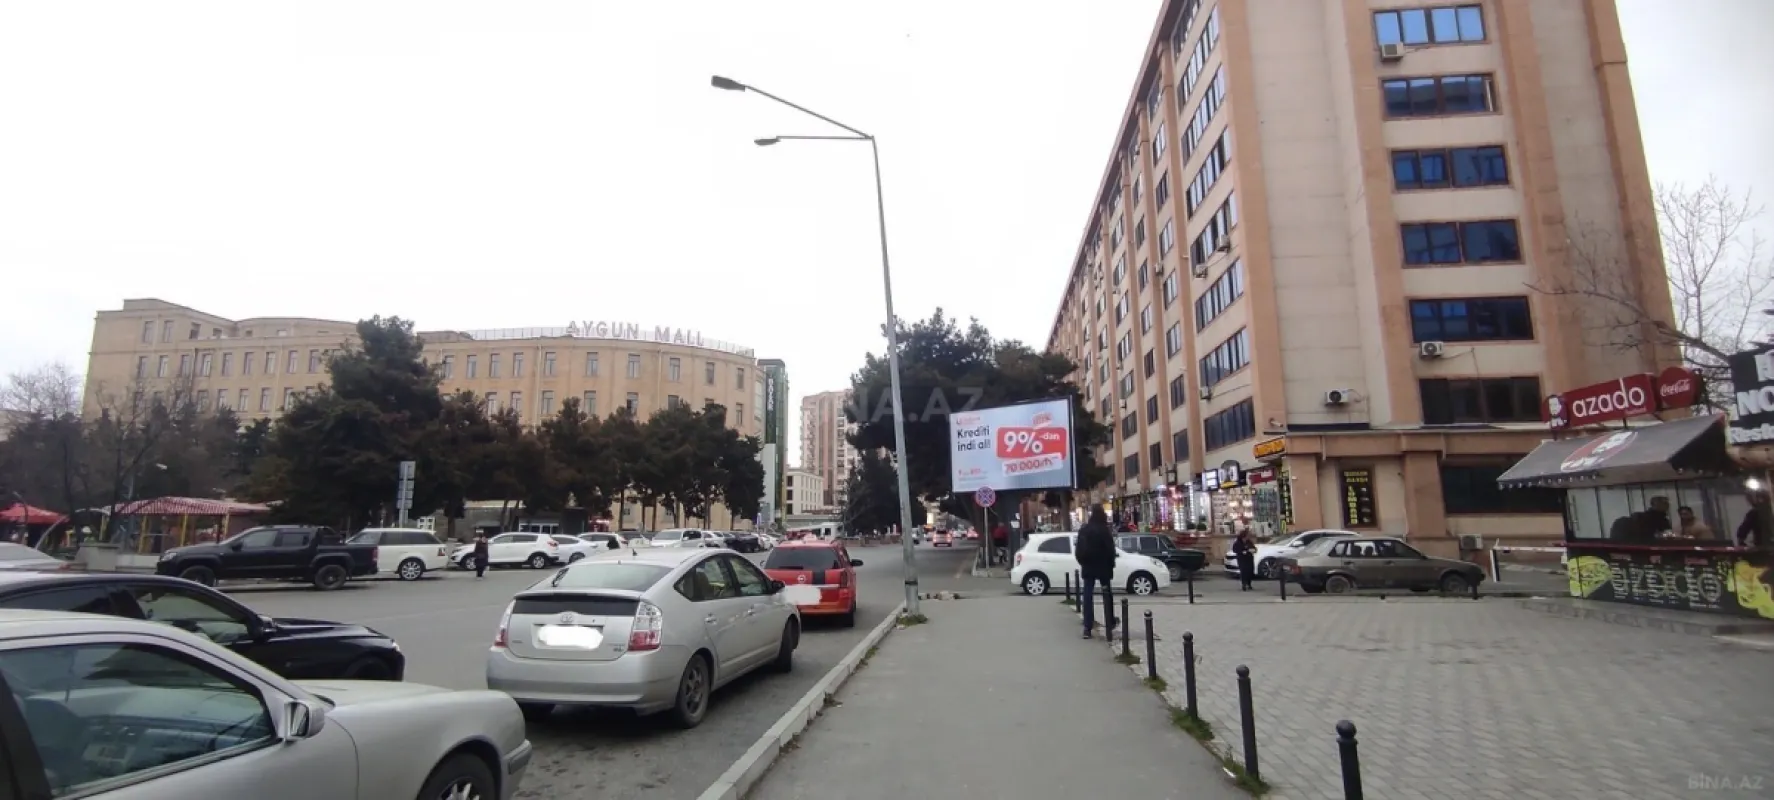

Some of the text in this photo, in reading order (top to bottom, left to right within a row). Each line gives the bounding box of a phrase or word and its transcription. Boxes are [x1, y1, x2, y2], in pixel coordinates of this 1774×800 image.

[567, 320, 704, 347] AYGUN MALL
[1572, 378, 1645, 418] azado
[957, 425, 990, 439] Krediti
[957, 440, 976, 452] indi
